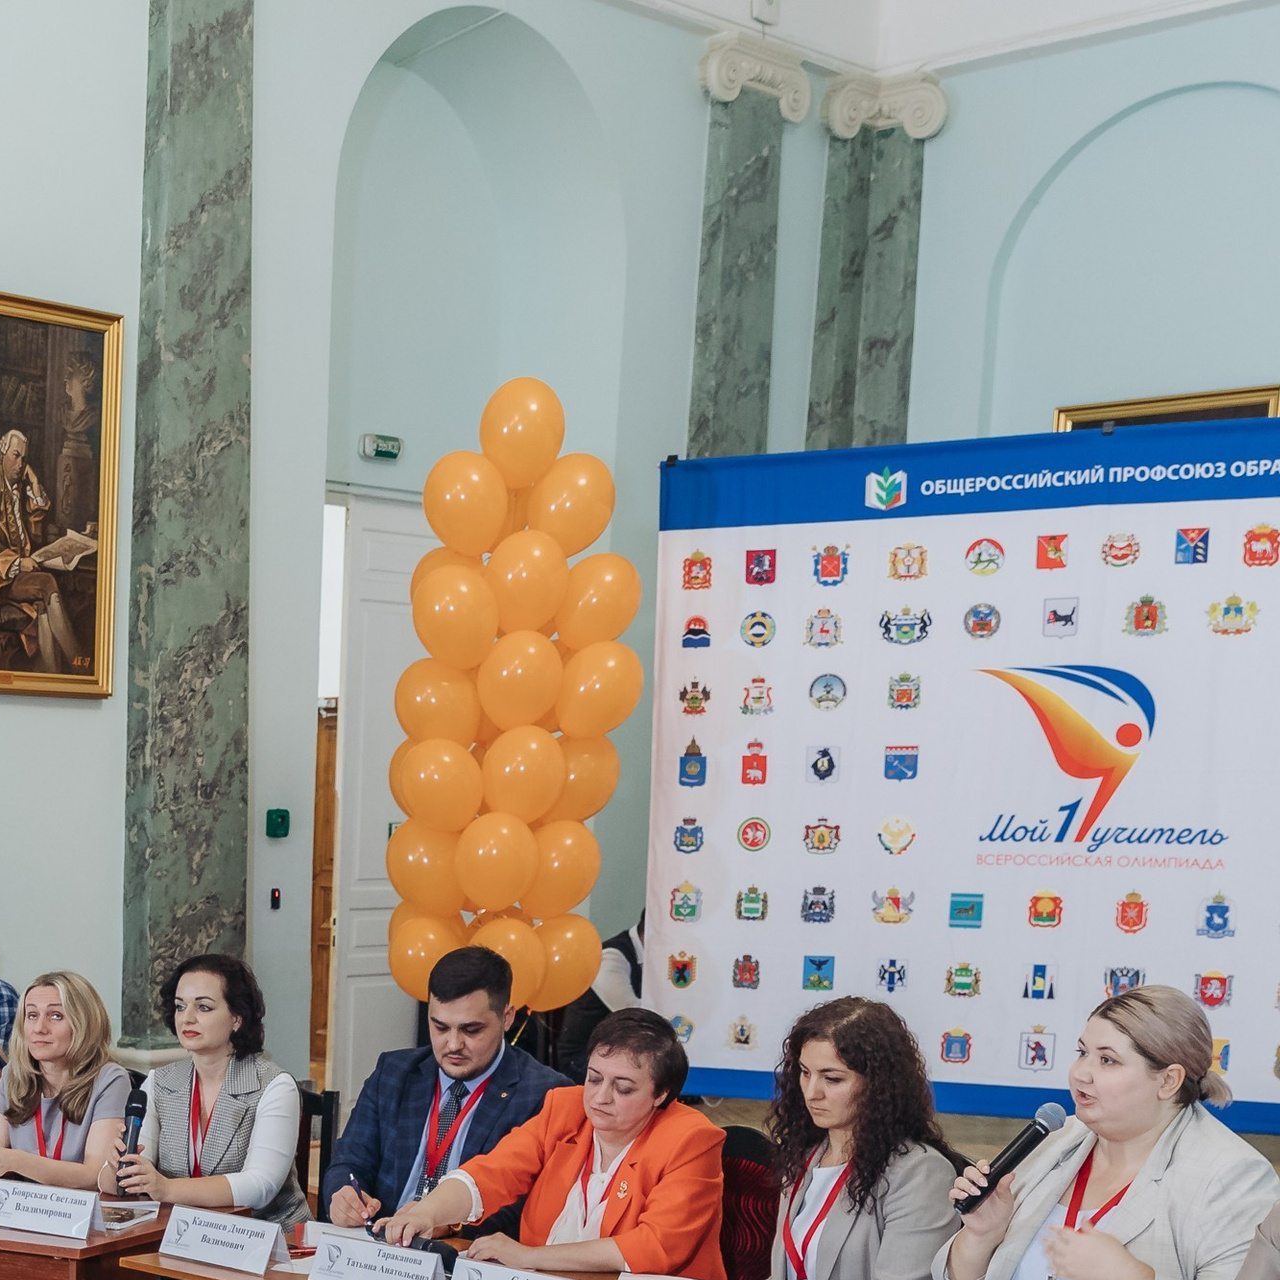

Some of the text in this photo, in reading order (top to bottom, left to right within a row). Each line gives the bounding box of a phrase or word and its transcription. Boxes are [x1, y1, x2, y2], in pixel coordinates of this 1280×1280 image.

[920, 458, 1280, 497] ОБЩЕРОССИЙСКИЙ ПРОФСОЮЗ ОБРА
[978, 814, 1052, 843] Мой
[1086, 826, 1229, 853] учитель
[976, 854, 1225, 870] ВСЕРОССИЙСКАЯ ОЛИМПИАДА
[11, 1187, 88, 1206] Боярская Светлана
[15, 1202, 72, 1219] Владимировна
[191, 1216, 266, 1239] Казанцев Дмитрий
[200, 1234, 245, 1251] Вадимович
[346, 1257, 377, 1271] Татьяна
[376, 1248, 423, 1266] Тараканова
